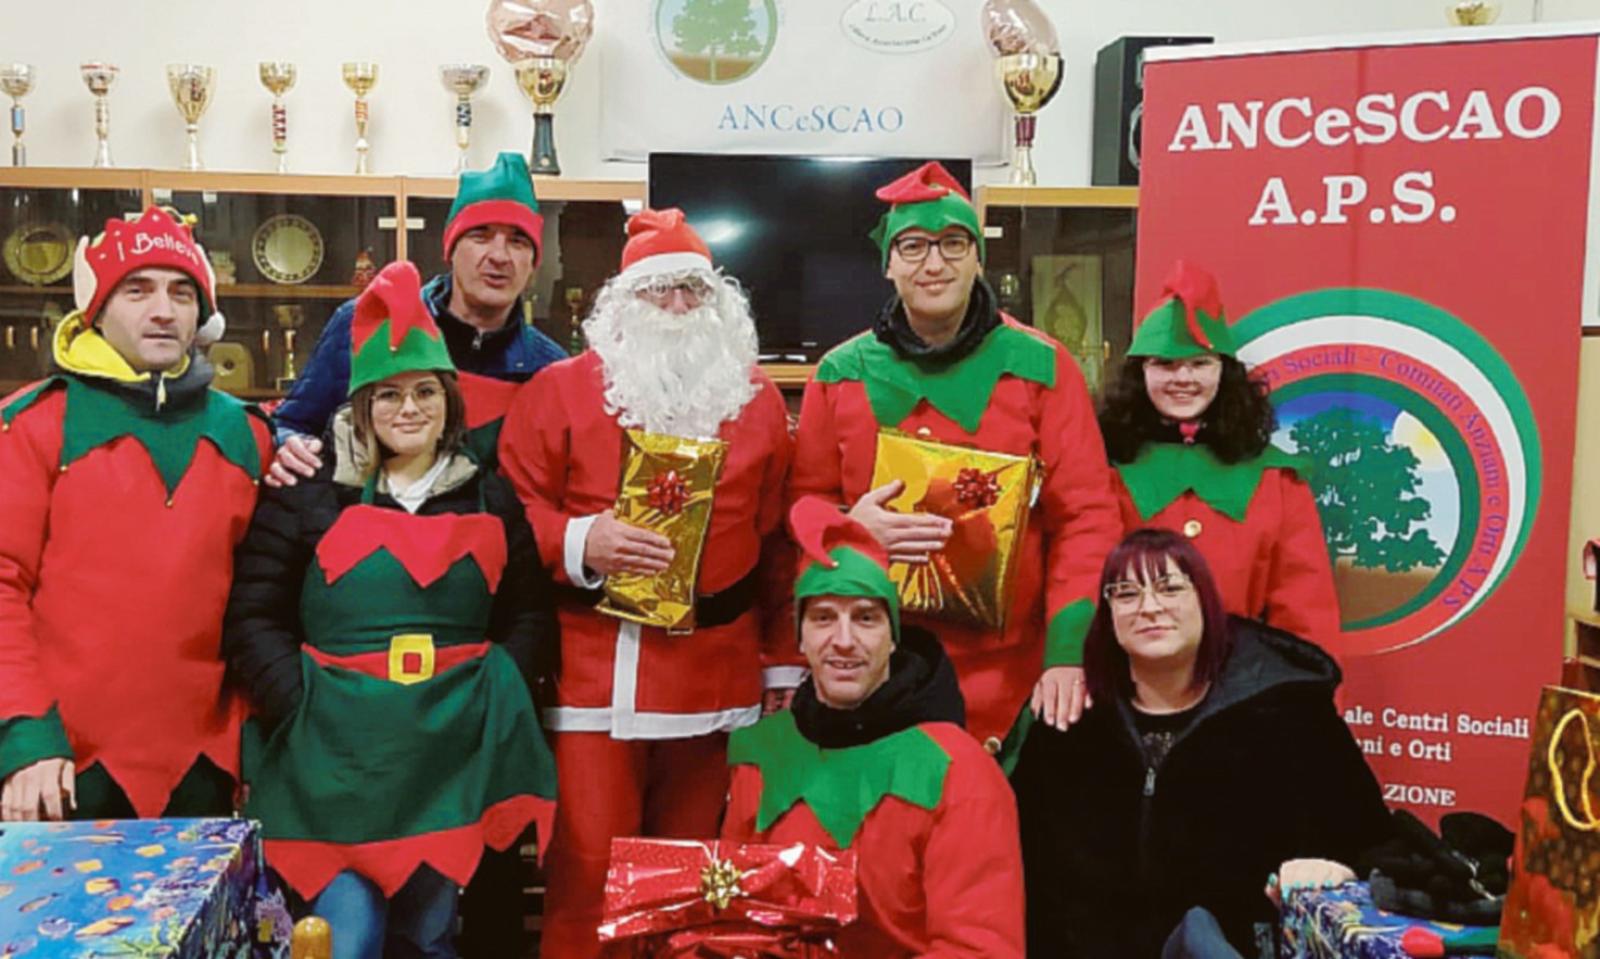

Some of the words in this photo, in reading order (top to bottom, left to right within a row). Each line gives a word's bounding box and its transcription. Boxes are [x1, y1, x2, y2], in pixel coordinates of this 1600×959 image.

[718, 105, 904, 133] ANCeSCAO
[1168, 86, 1562, 152] ANCeSCAO
[1248, 171, 1456, 226] A.P.S.
[1284, 345, 1357, 373] Sociali
[1382, 708, 1449, 732] Centri
[1456, 714, 1530, 738] Sociali
[1389, 742, 1402, 756] e
[1408, 738, 1452, 762] Orti
[1383, 784, 1456, 805] ZIONE
